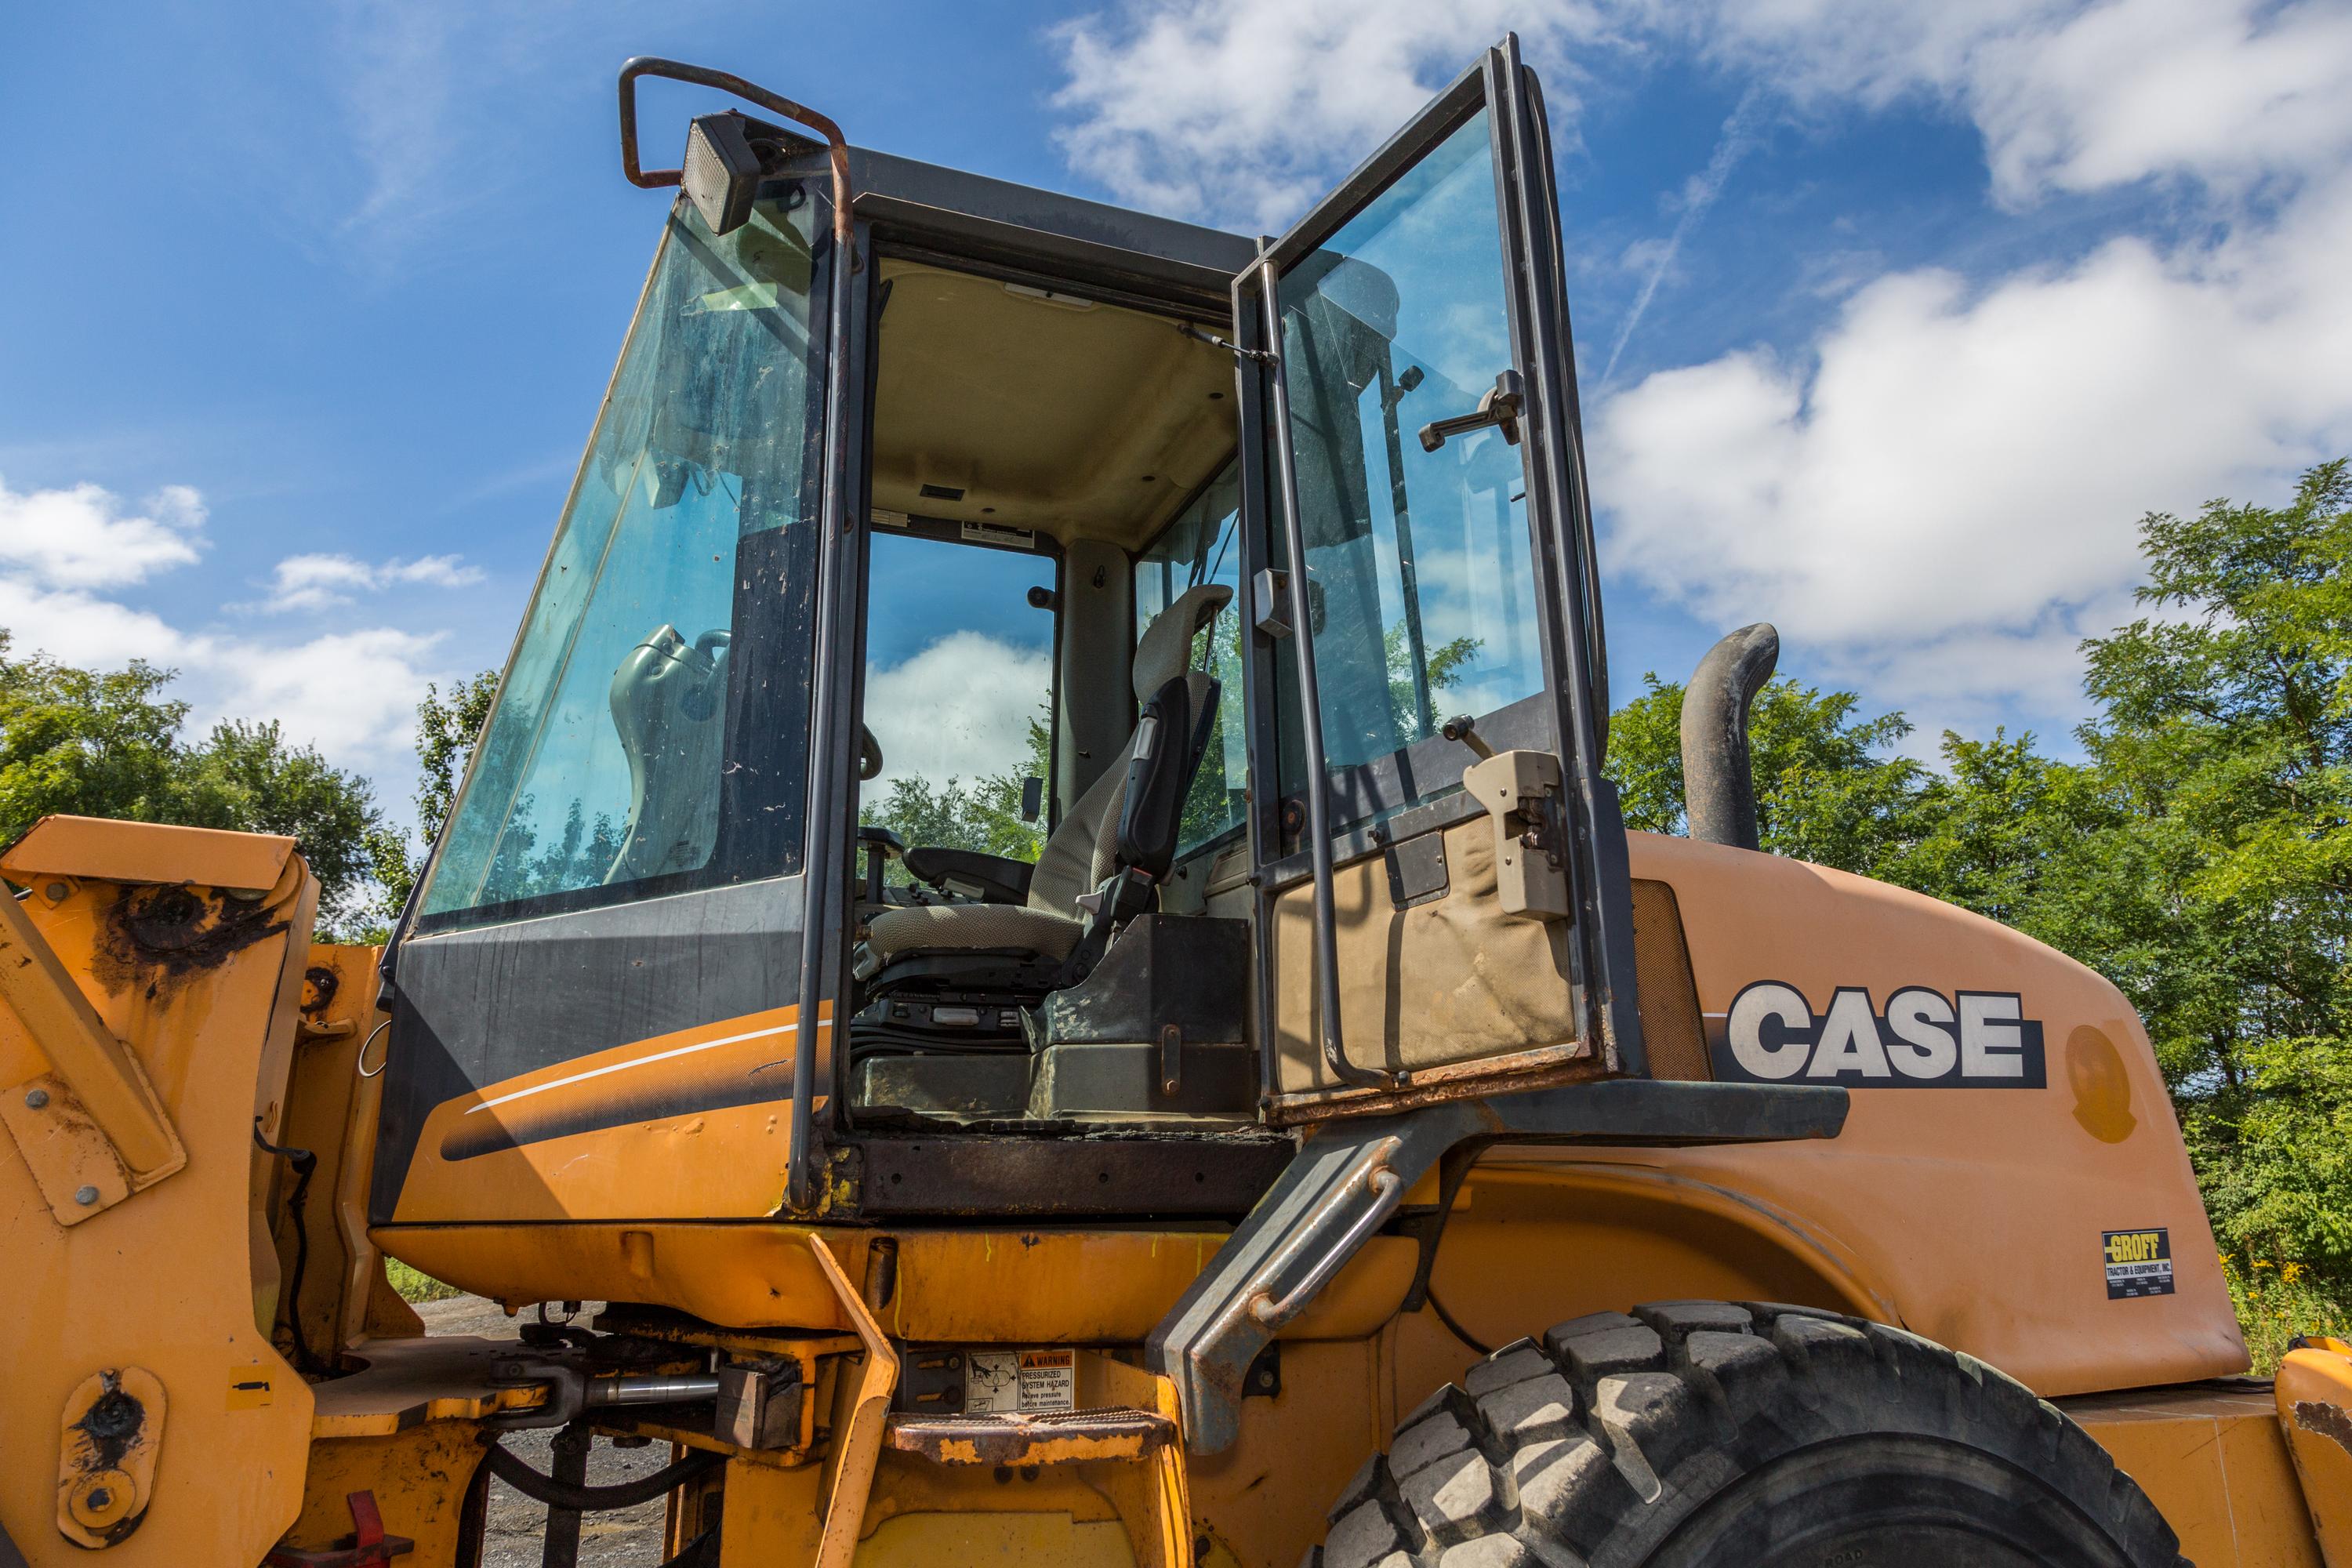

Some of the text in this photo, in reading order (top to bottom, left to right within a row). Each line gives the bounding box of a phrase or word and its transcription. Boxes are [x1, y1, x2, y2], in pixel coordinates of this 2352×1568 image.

[1728, 984, 2024, 1079] CASE
[2111, 1233, 2159, 1261] GROFF
[2107, 1266, 2129, 1276] TRACTOR
[2129, 1266, 2133, 1275] &
[1036, 1355, 1070, 1366] WARNING
[1022, 1370, 1062, 1379] PRESSURIZED
[1022, 1381, 1044, 1389] SYSTEM
[1022, 1399, 1037, 1408] before
[1824, 1549, 1864, 1568] ROAD
